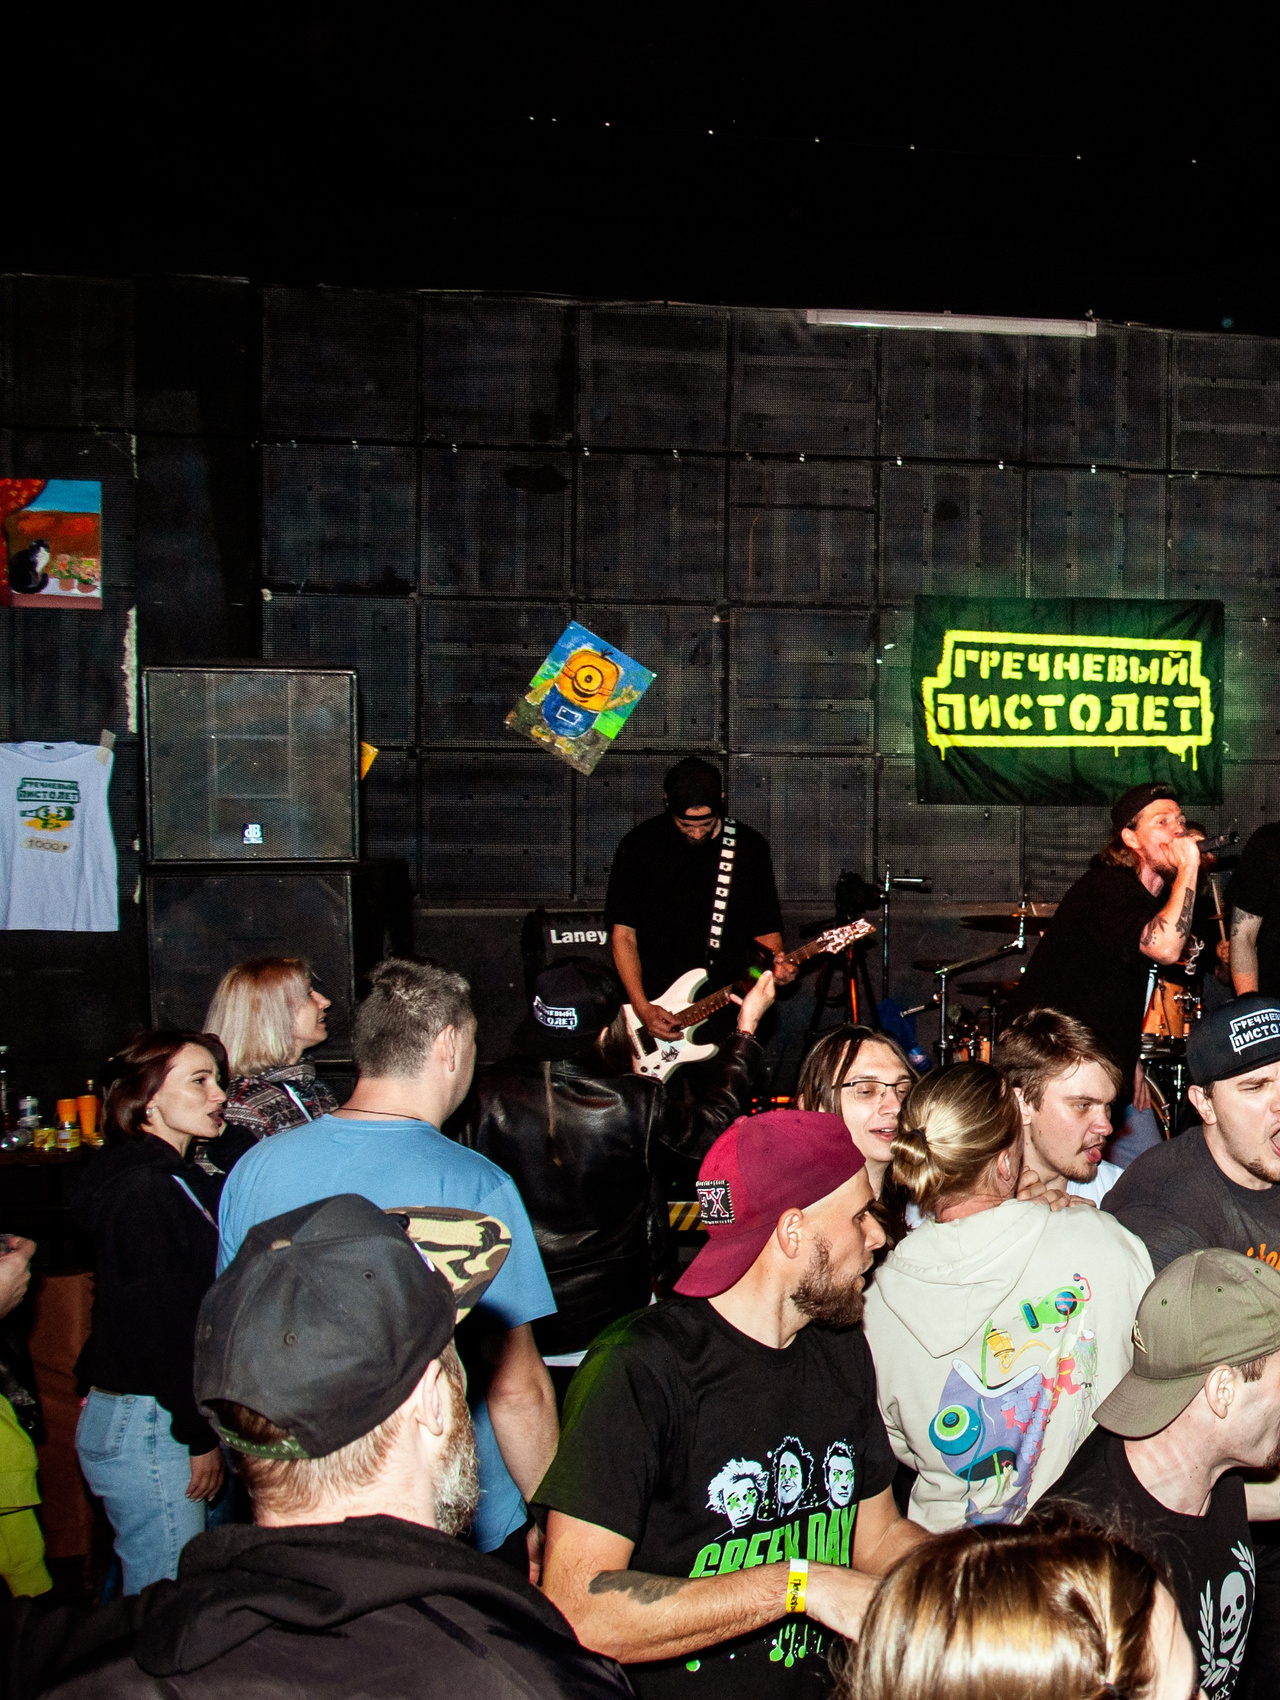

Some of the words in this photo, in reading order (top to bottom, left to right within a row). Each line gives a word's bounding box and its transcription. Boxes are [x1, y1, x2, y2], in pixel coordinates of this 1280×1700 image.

[953, 648, 1189, 686] ГРЕЧНЕВЫЙ
[937, 692, 1200, 733] ПИСТОЛЕТ
[550, 929, 608, 945] Laney
[688, 1520, 800, 1579] GREEN
[806, 1503, 858, 1568] DAY
